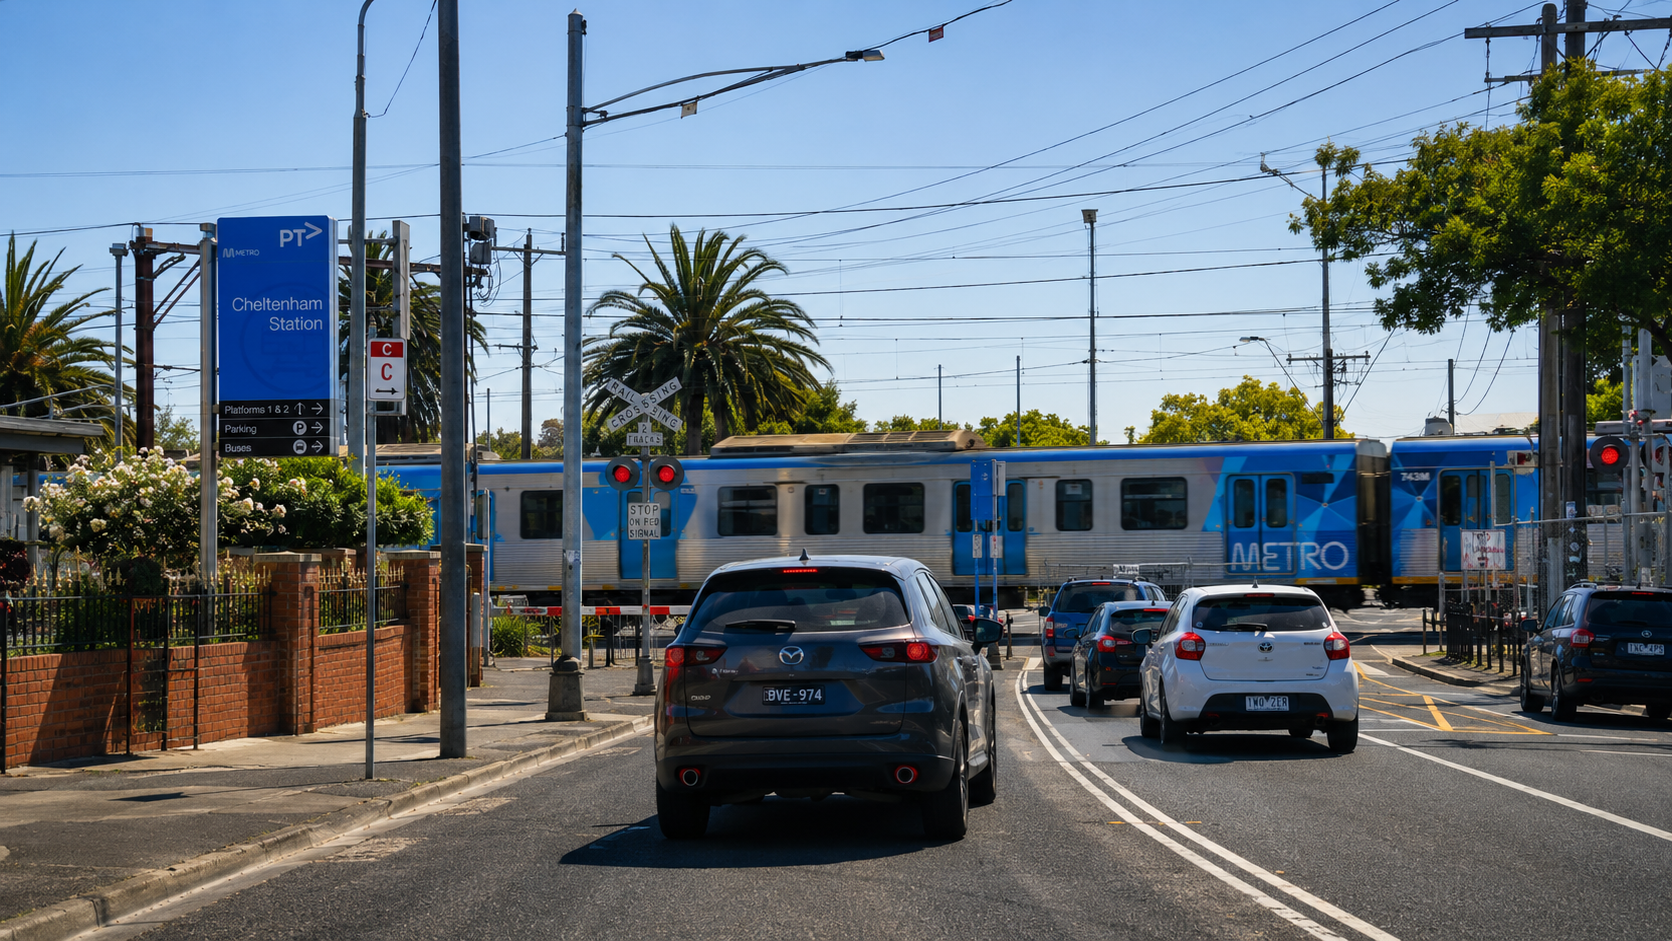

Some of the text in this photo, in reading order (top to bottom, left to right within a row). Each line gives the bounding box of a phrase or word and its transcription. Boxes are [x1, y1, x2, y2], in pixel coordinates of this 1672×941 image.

[235, 249, 260, 257] METRO
[232, 296, 323, 312] Cheltenham
[269, 316, 323, 332] Station
[382, 343, 392, 356] C
[381, 362, 393, 381] C
[611, 381, 635, 403] RAIL
[224, 405, 290, 415] Platforms 1 & 2
[224, 424, 257, 435] Parking
[642, 424, 647, 434] 2
[224, 443, 252, 453] Buses
[630, 505, 659, 515] STOP
[629, 517, 659, 526] ON RED
[629, 529, 659, 538] SIGNAL
[1231, 541, 1349, 571] METRO
